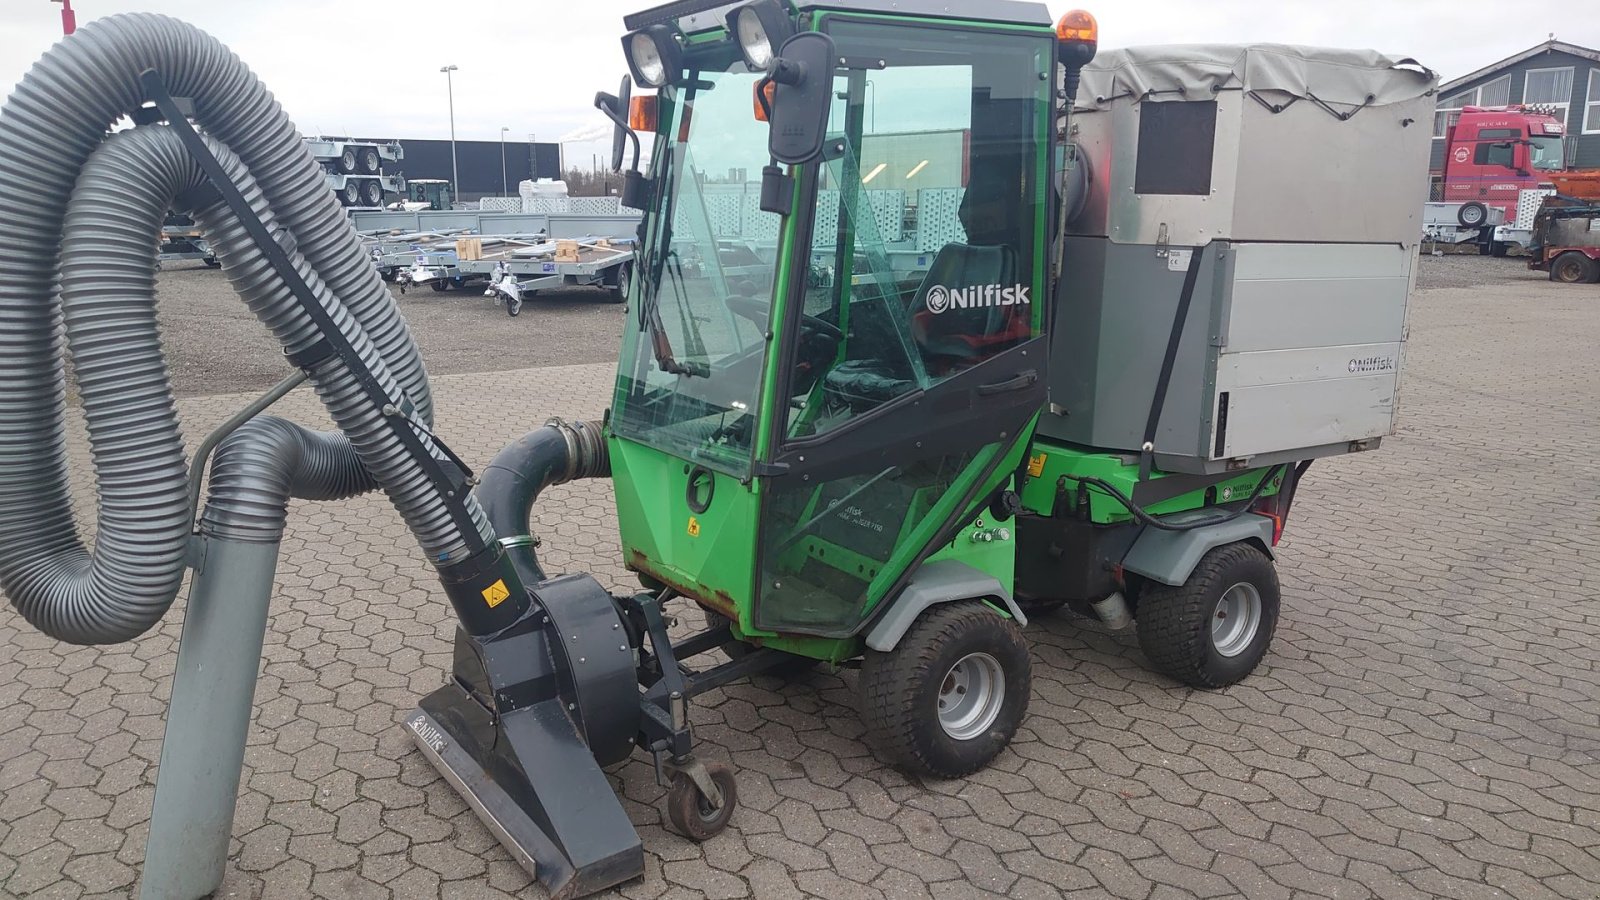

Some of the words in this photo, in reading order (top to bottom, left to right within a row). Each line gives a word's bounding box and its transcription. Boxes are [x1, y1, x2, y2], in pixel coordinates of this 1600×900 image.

[950, 283, 1030, 309] Nilfisk
[1357, 357, 1393, 372] Nilfisk
[1232, 483, 1253, 493] Nilfisk
